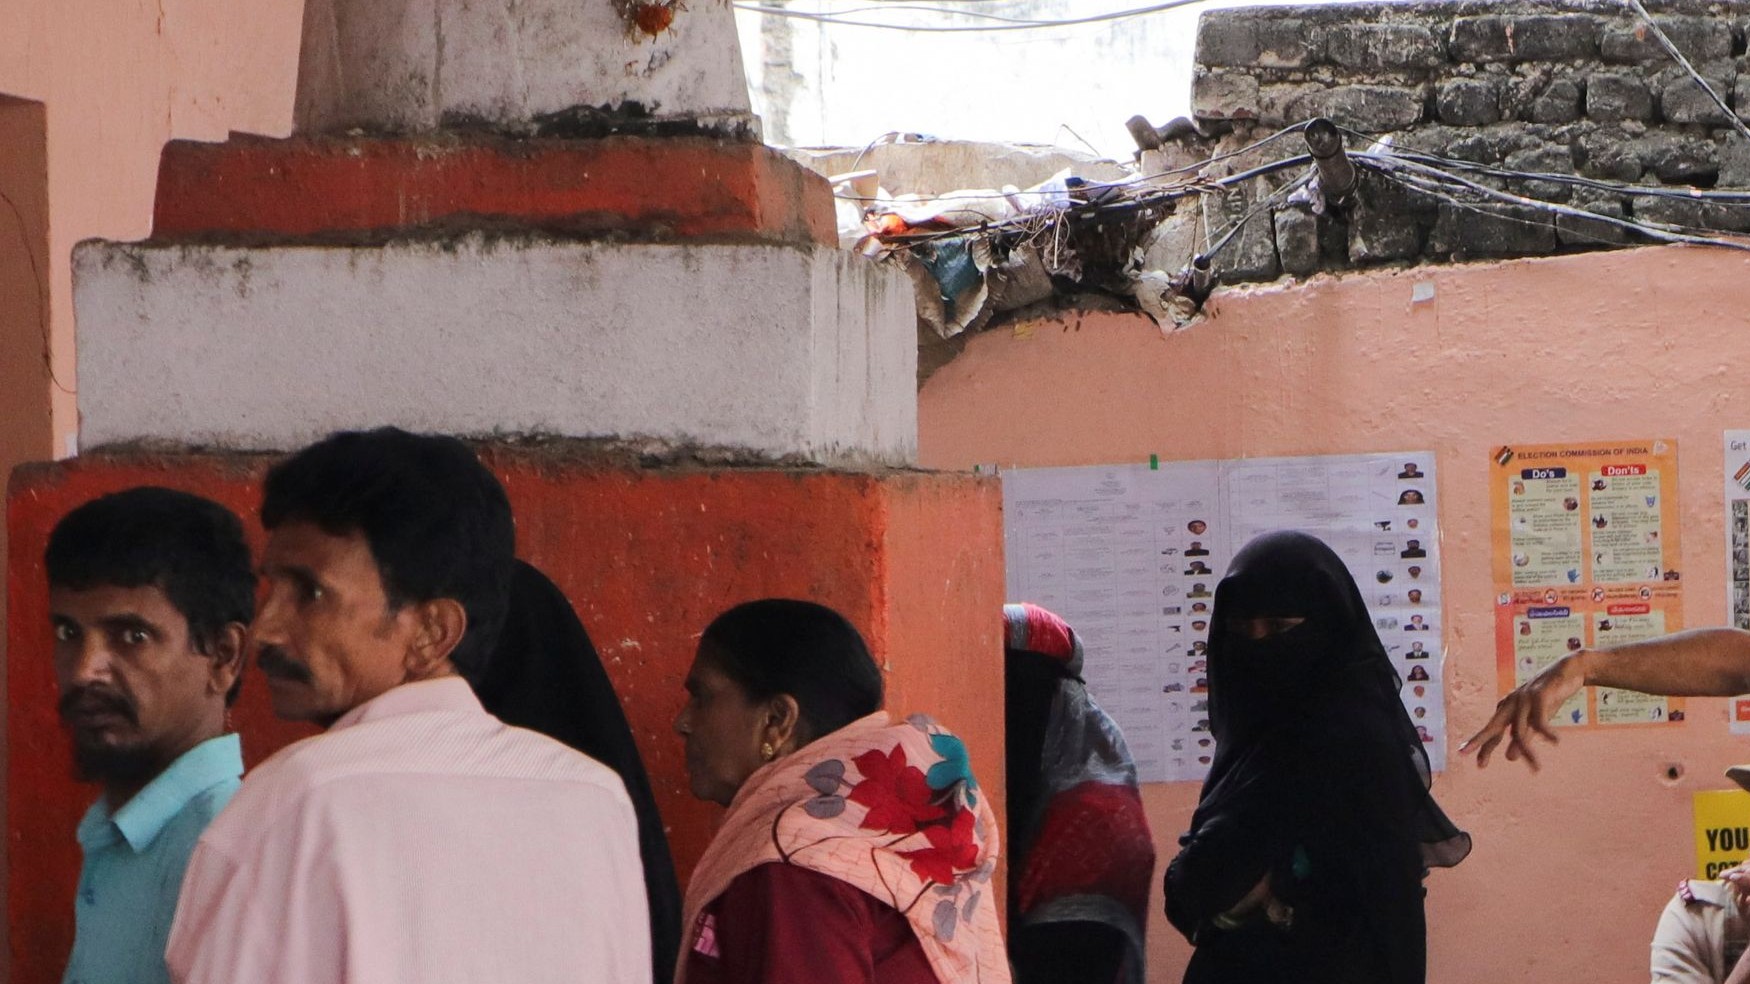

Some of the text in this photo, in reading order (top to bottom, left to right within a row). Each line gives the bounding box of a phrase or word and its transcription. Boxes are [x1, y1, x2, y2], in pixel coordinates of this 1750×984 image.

[1730, 440, 1747, 451] Get
[1518, 447, 1648, 460] ELECTION COMMISSION OF INDIA
[1532, 469, 1555, 479] Do's
[1706, 827, 1749, 852] YOU
